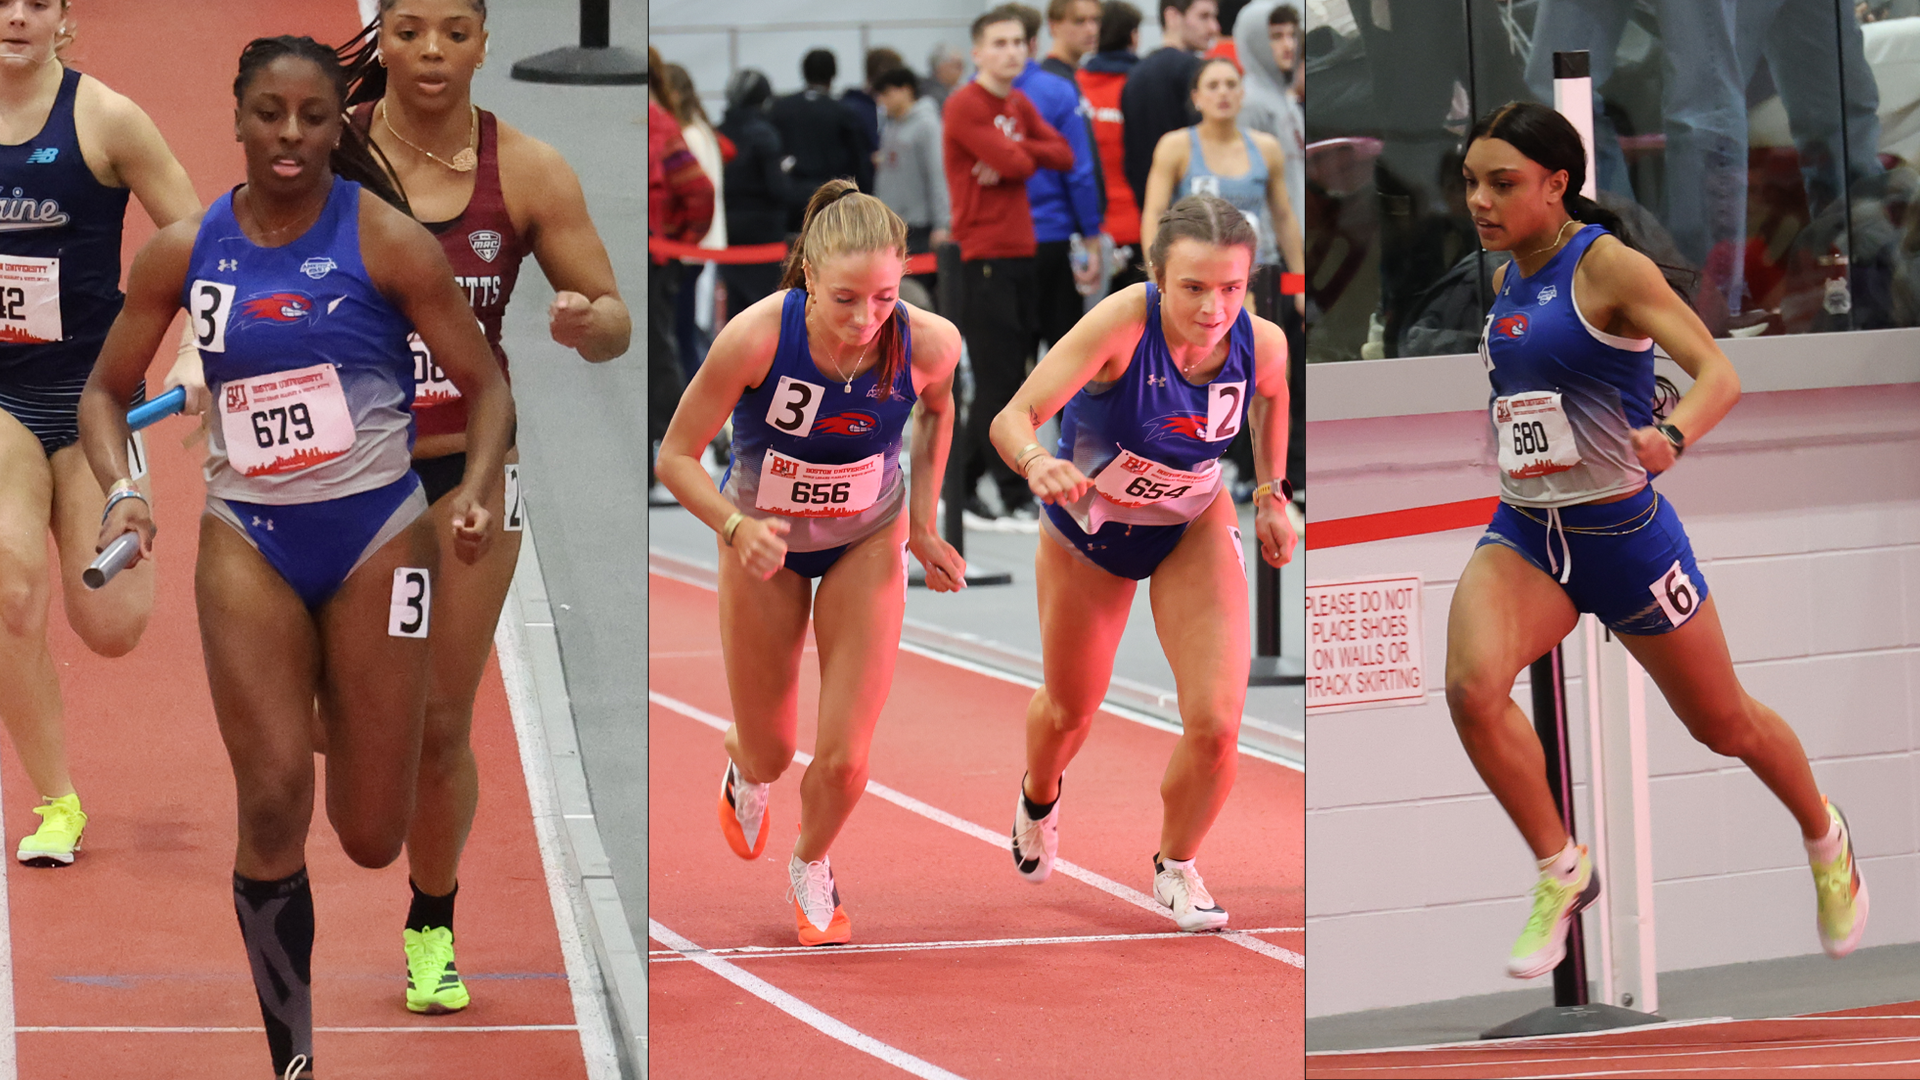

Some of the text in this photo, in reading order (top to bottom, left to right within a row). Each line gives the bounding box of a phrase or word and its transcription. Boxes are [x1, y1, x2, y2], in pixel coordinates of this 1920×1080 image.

[0, 187, 67, 223] aine
[199, 285, 221, 346] 3
[774, 383, 812, 431] 3
[1216, 386, 1240, 439] 2
[251, 402, 315, 449] 679
[1513, 421, 1549, 455] 680
[771, 456, 799, 476] BU
[805, 461, 874, 475] BOSTON UNIVERSITY
[1122, 456, 1154, 475] BU
[791, 481, 851, 504] 656
[1125, 477, 1192, 499] 654
[399, 572, 425, 633] 3
[1306, 587, 1413, 617] PLEASE DO NOT
[1665, 569, 1692, 615] 6
[1312, 615, 1408, 644] PLACE SHOES
[1313, 641, 1411, 670] ON WALLS OR
[1306, 667, 1420, 698] TRACK SKIRTING
